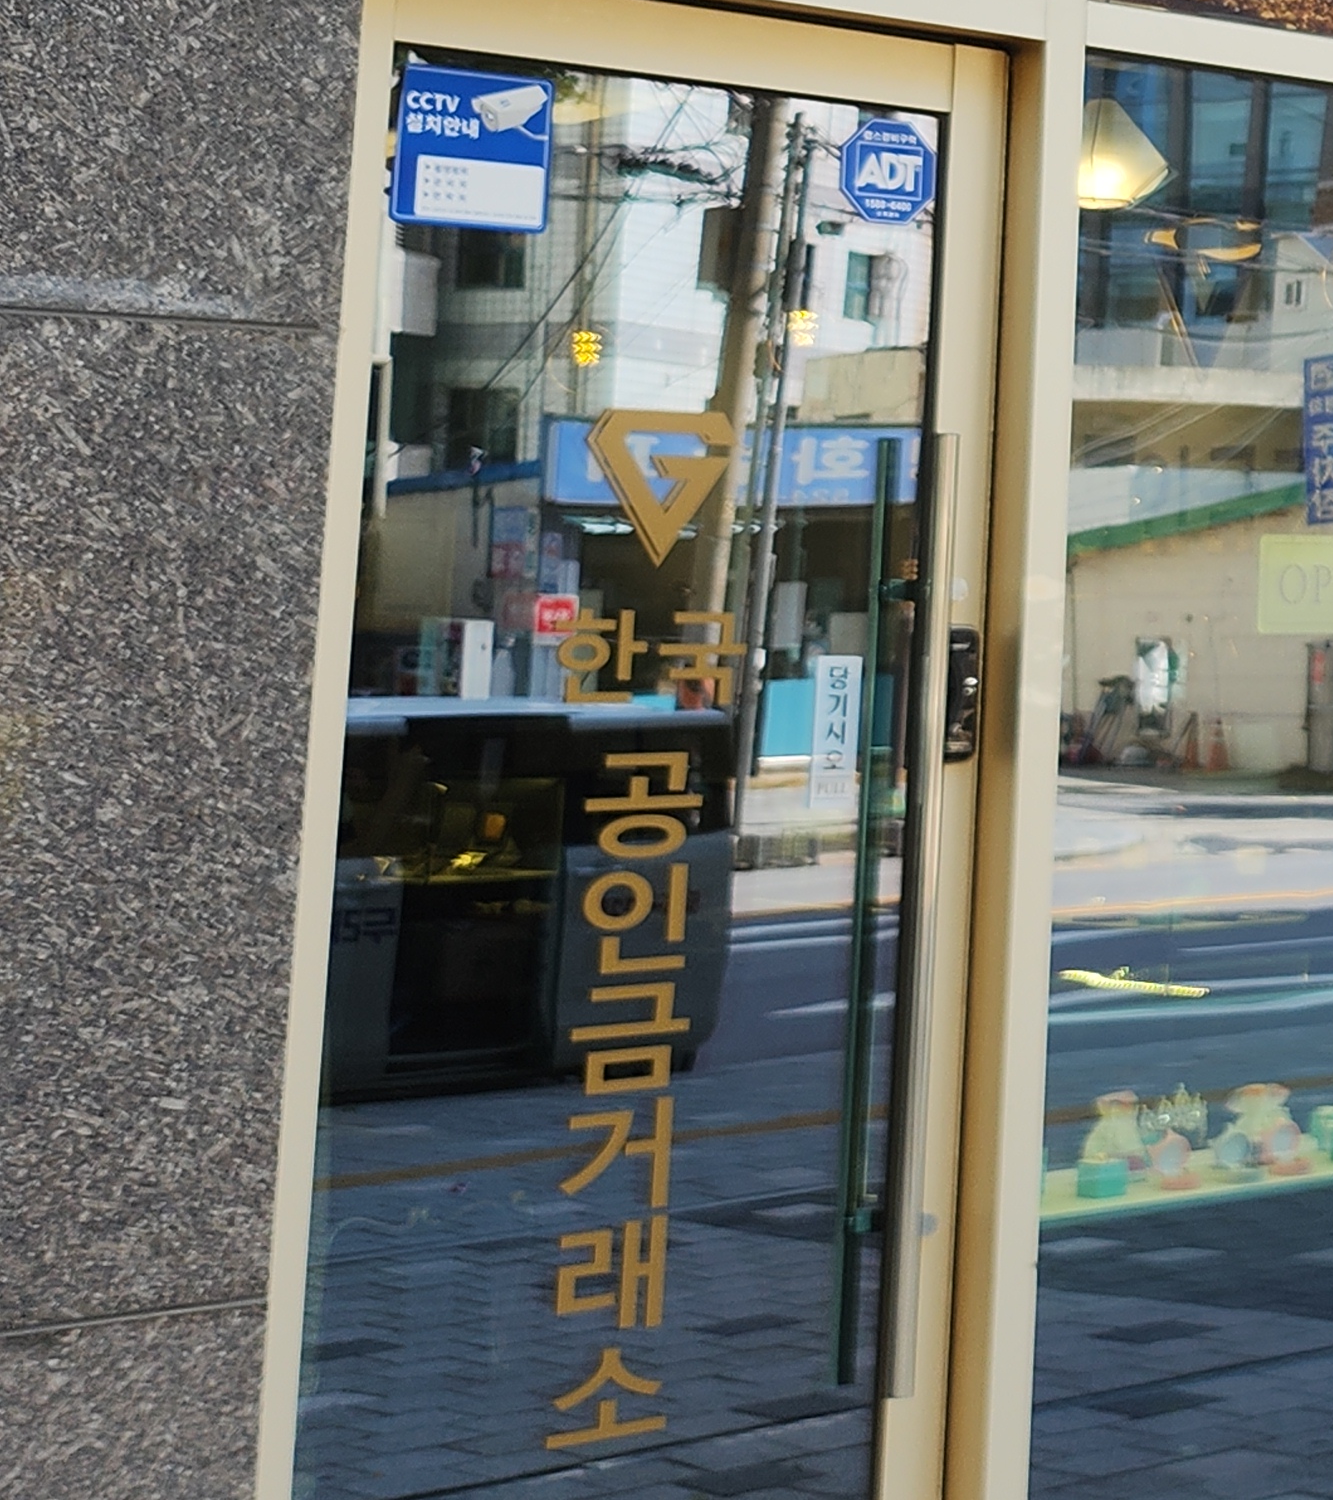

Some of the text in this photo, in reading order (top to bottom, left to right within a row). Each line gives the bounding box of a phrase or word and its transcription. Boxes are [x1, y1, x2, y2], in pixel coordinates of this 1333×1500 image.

[405, 111, 480, 141] 설치안내
[406, 89, 461, 113] CCTV
[856, 151, 923, 192] ADT
[554, 606, 748, 705] 한국
[822, 665, 851, 770] 당기시오
[545, 750, 704, 1450] 공인금거래소
